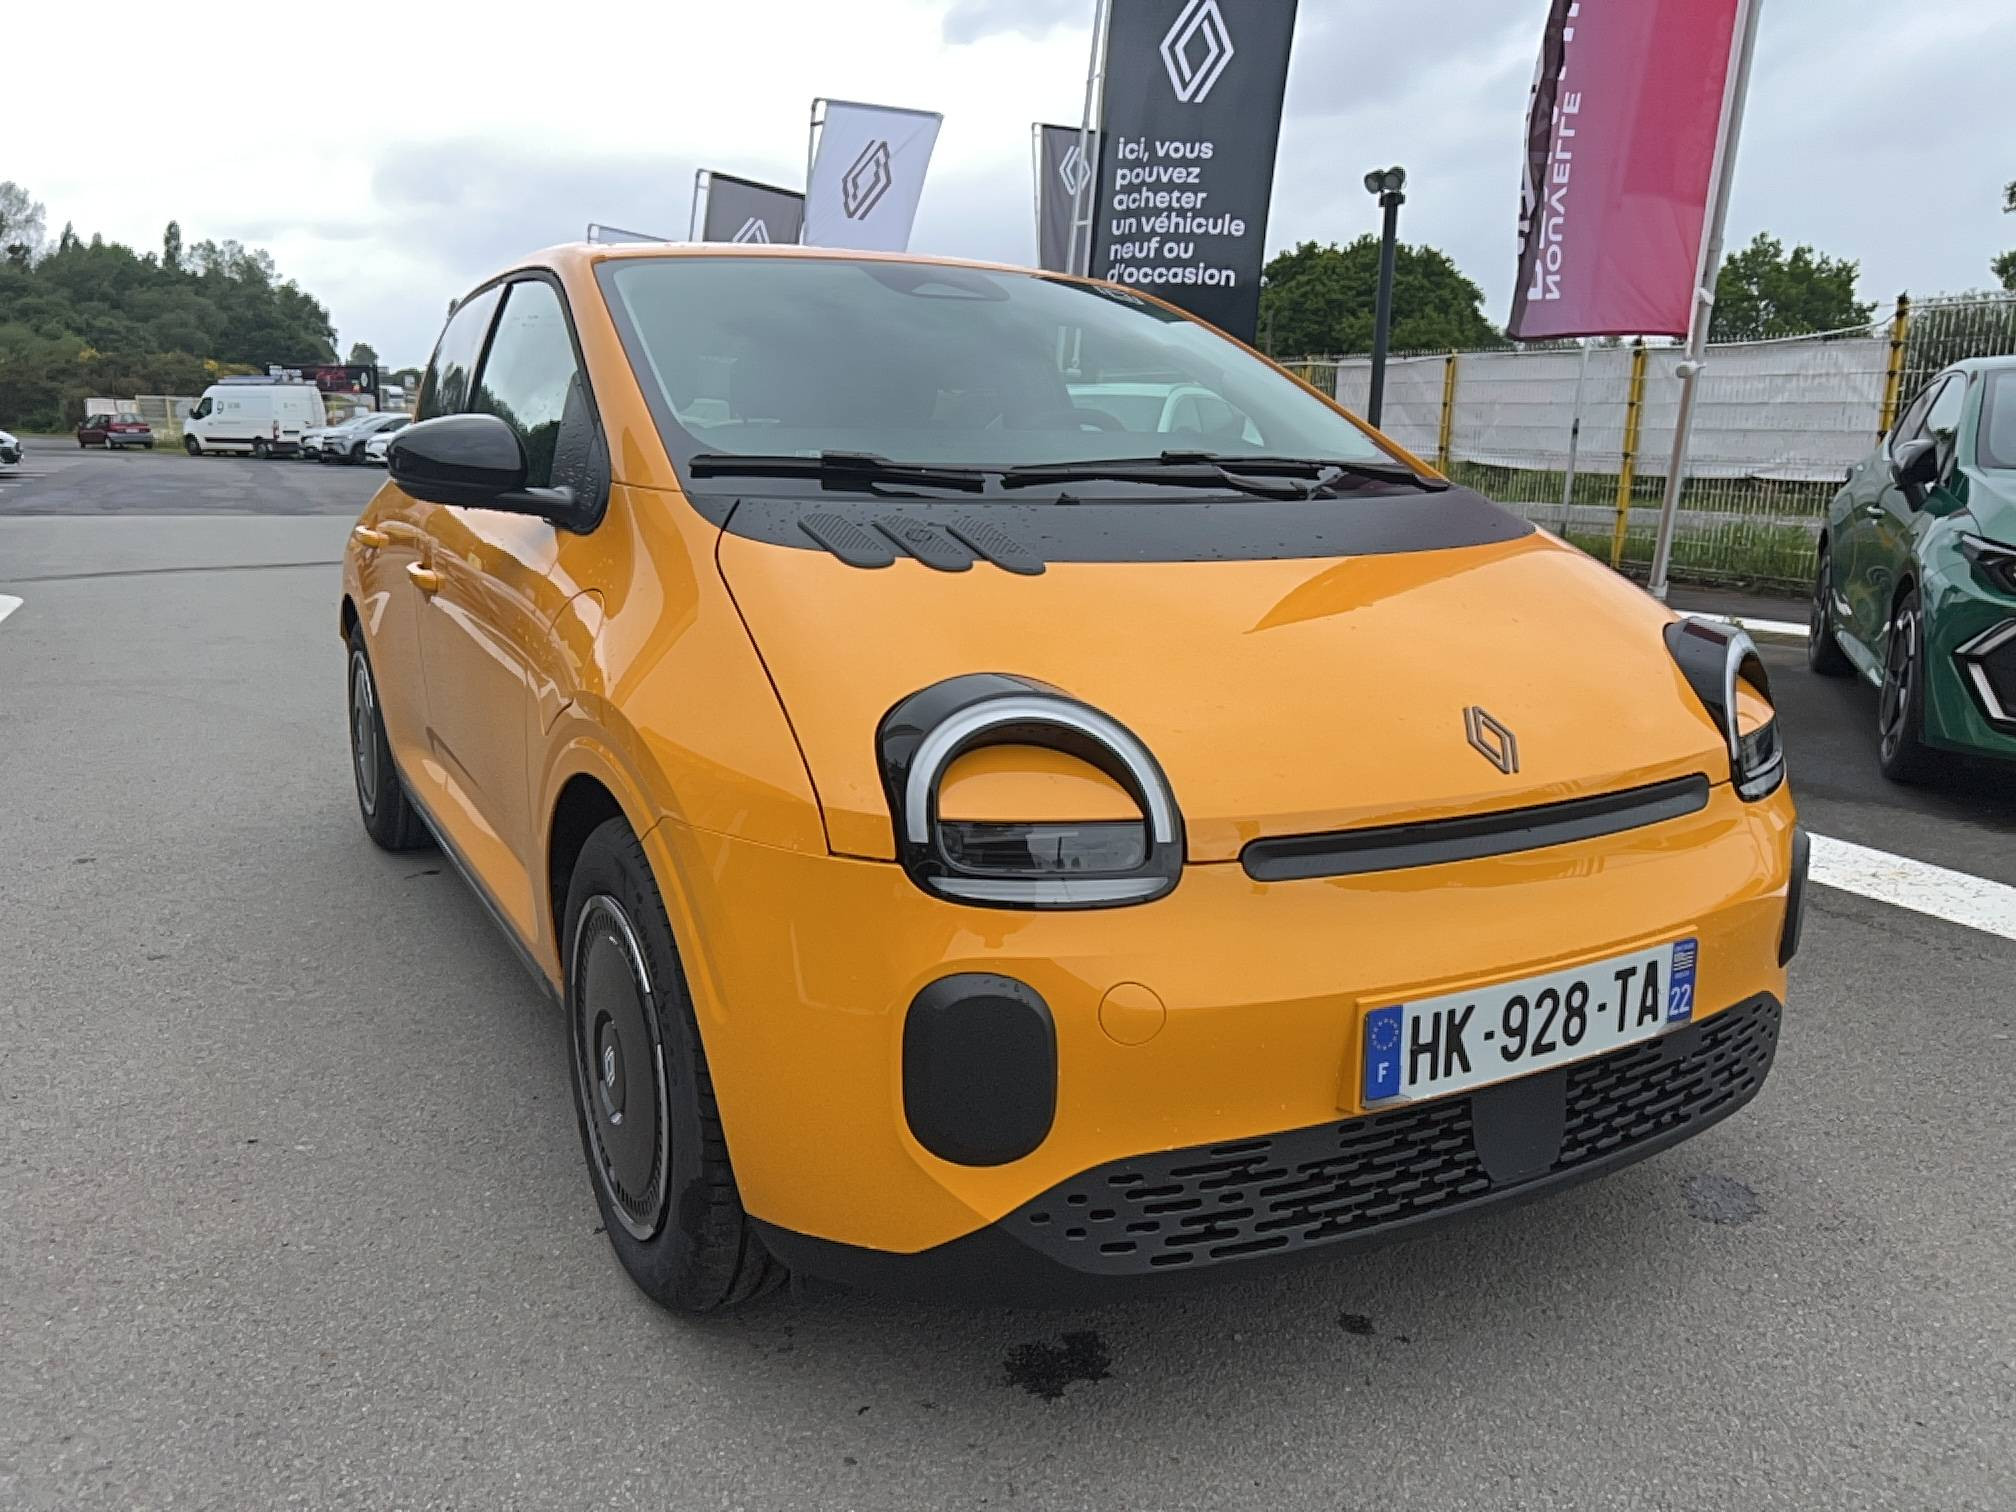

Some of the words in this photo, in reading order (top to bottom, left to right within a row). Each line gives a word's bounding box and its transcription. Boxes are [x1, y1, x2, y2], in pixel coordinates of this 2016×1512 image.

[1117, 137, 1149, 162] ici,
[1155, 141, 1213, 159] vous
[1115, 166, 1200, 190] pouvez
[1113, 186, 1206, 210] acheter
[1111, 217, 1137, 235] un
[1141, 212, 1245, 236] véhicule
[1110, 237, 1161, 260] neuf
[1163, 242, 1194, 259] ou
[1107, 263, 1236, 287] d'occasion
[1669, 984, 1690, 1016] 22
[1408, 960, 1660, 1086] HK-928-TA
[1377, 1062, 1390, 1083] F
